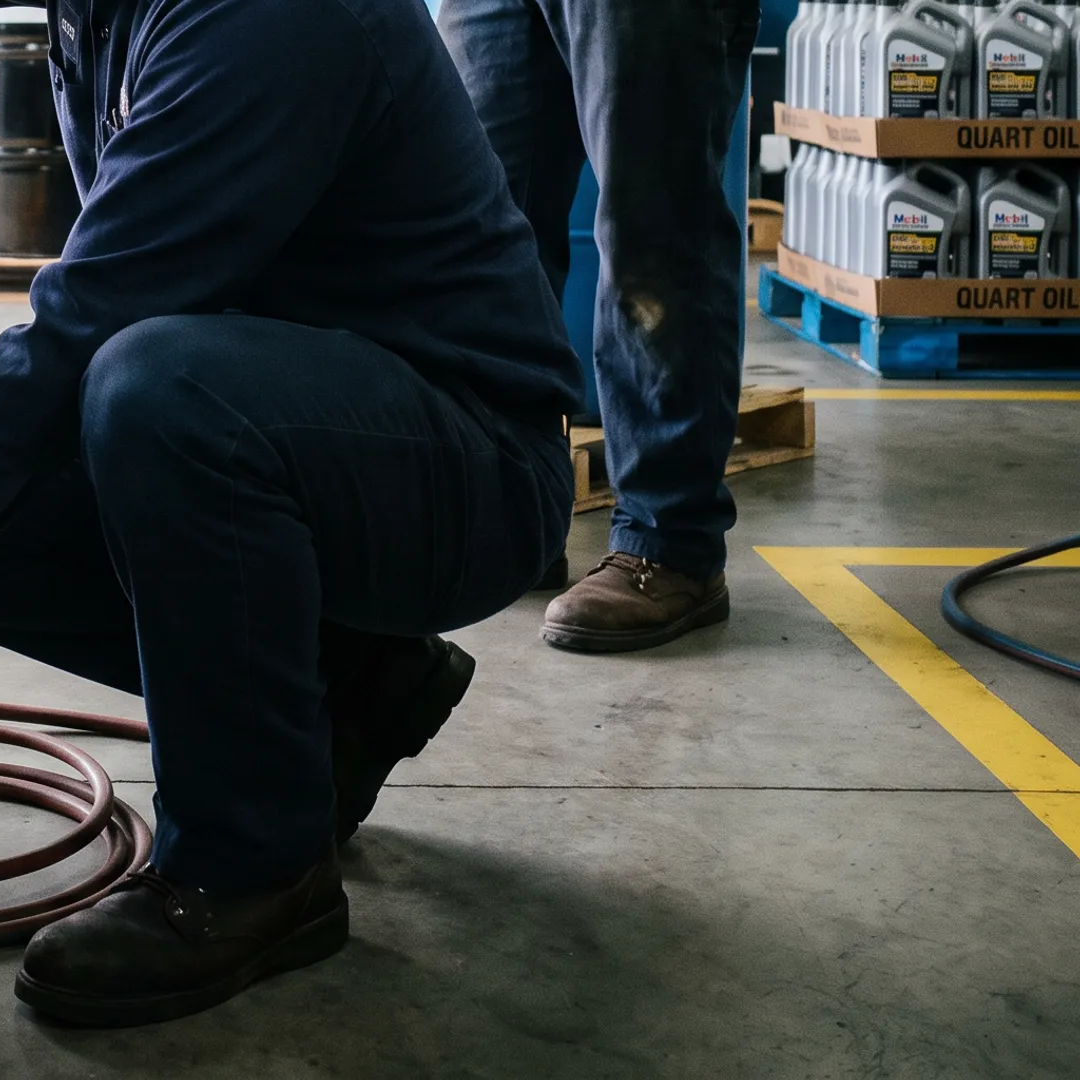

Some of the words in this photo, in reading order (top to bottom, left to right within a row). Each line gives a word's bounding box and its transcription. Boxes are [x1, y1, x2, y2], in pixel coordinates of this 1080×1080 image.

[957, 126, 1035, 149] QUART
[1043, 126, 1080, 149] OIL
[956, 287, 1036, 310] QUART
[1042, 287, 1080, 310] OIL
